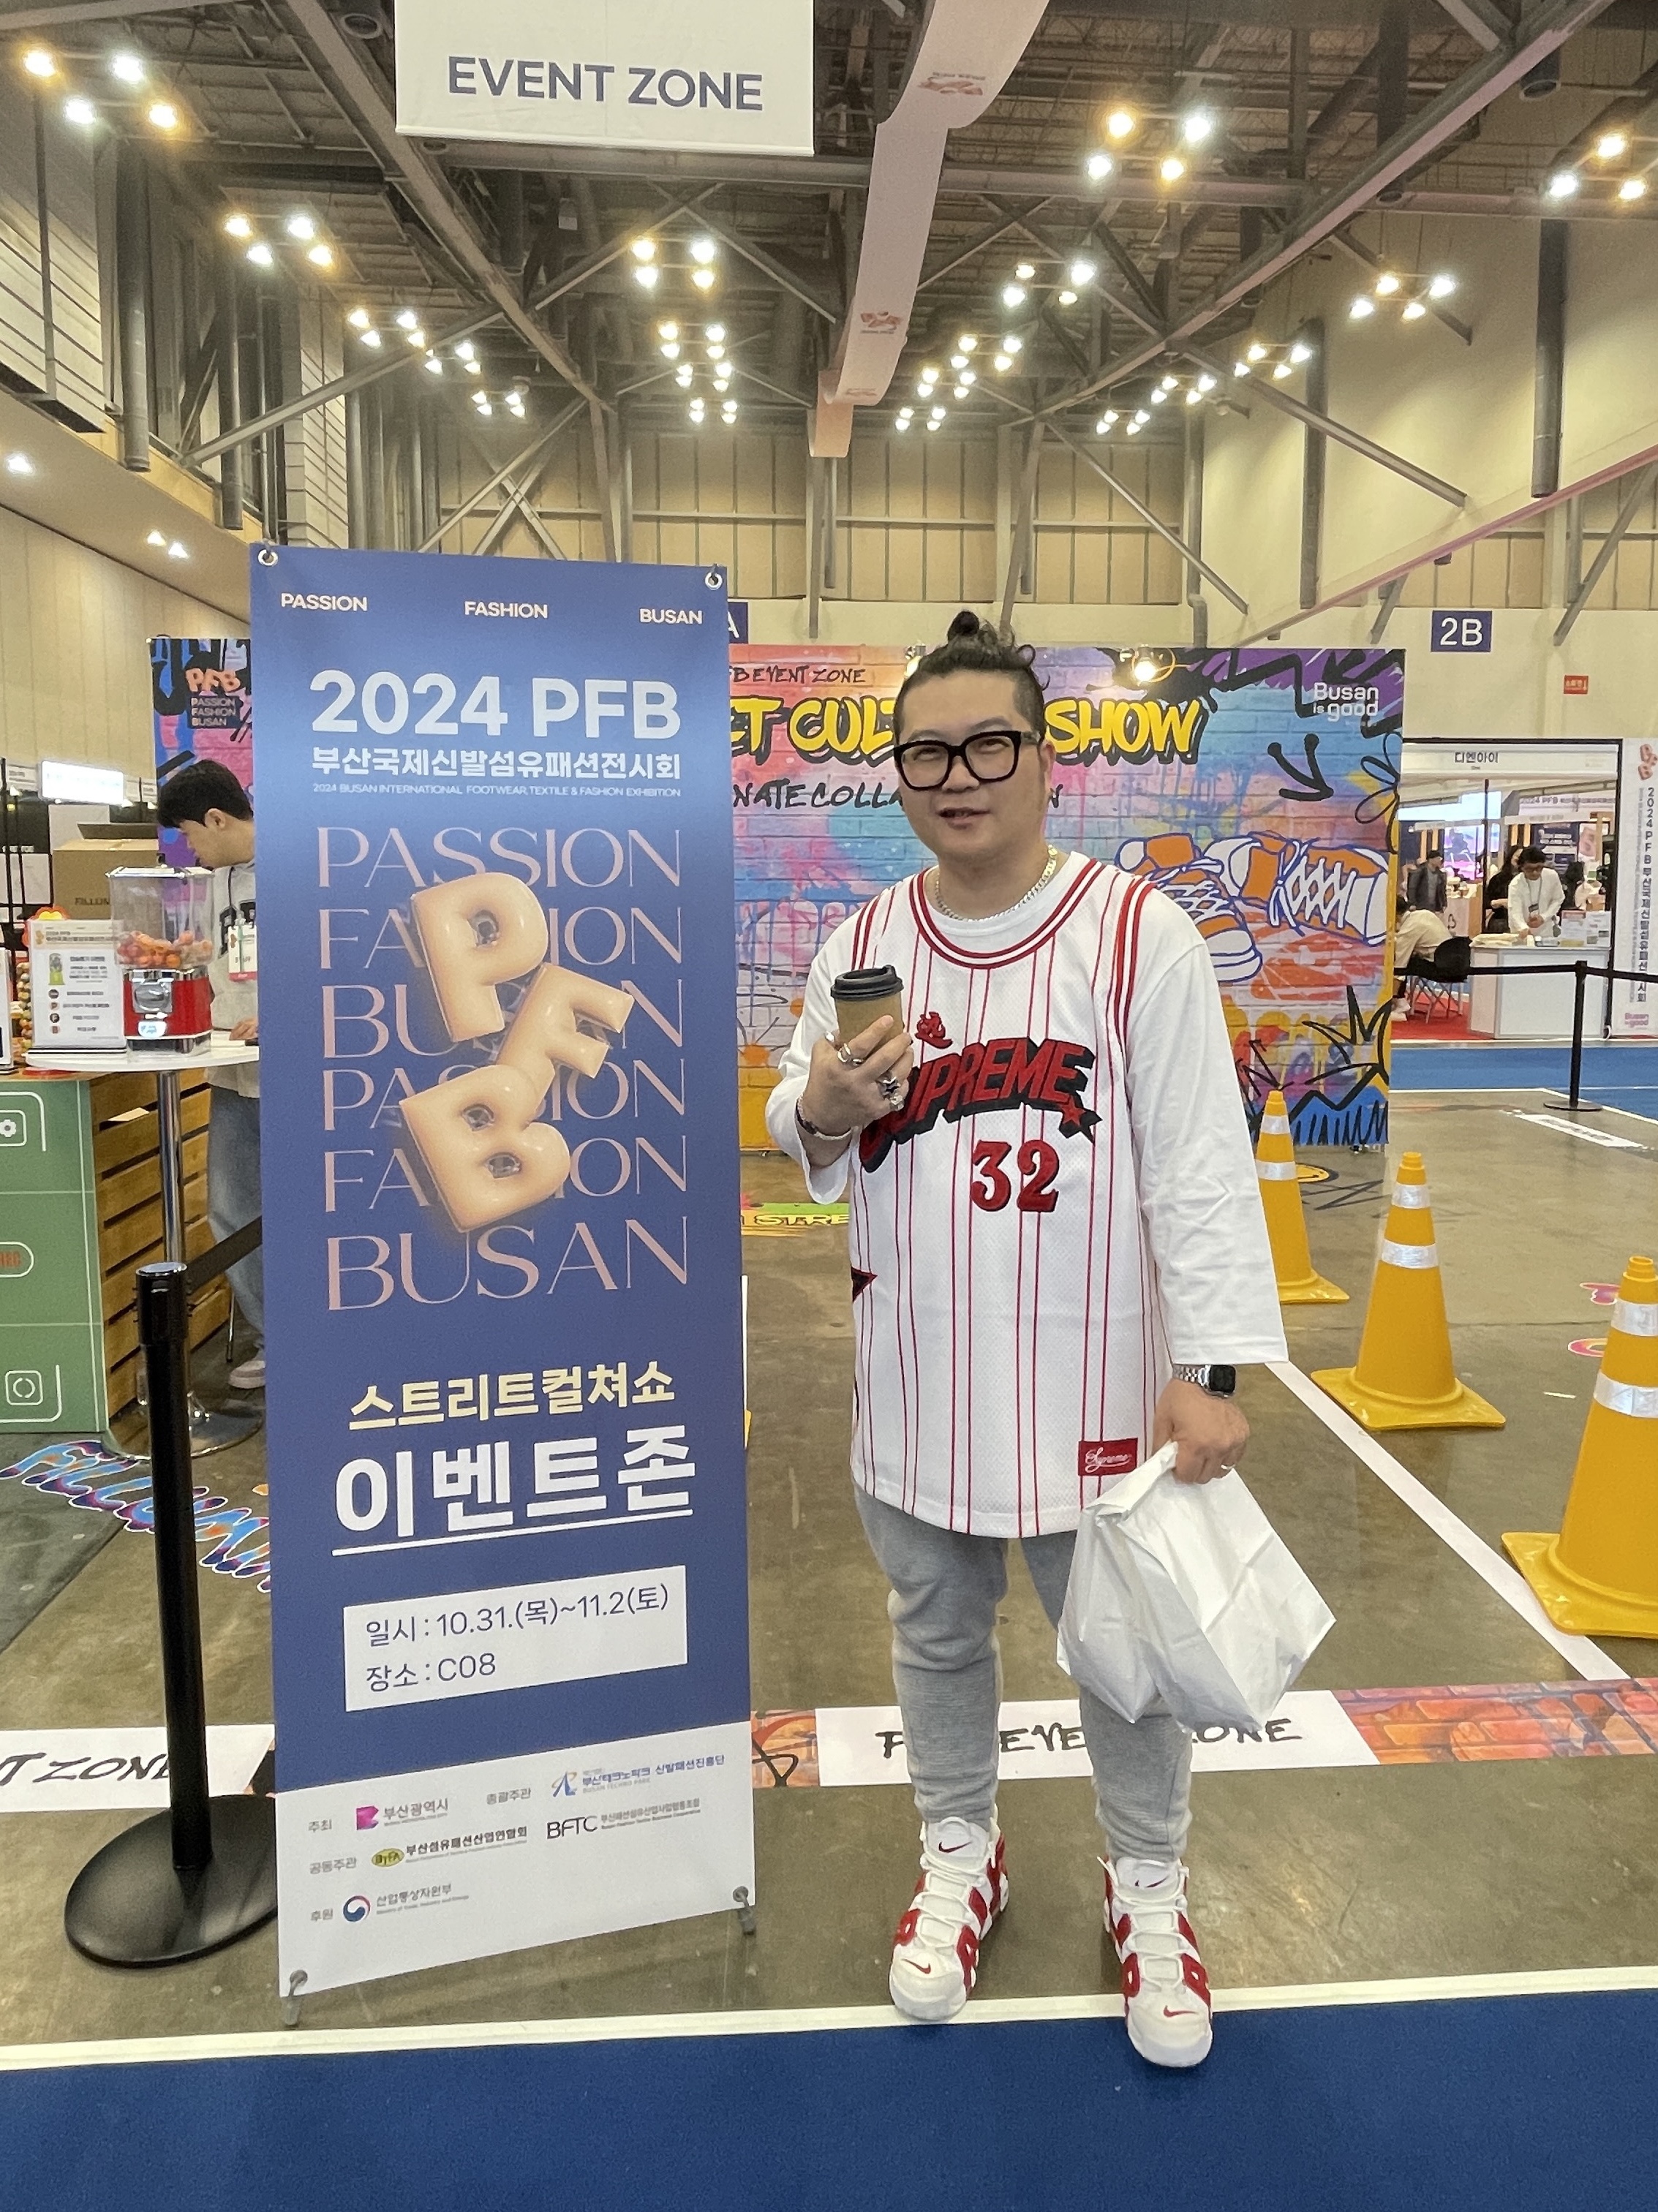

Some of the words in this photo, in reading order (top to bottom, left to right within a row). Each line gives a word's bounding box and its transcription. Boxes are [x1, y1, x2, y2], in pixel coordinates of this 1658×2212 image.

[448, 56, 614, 102] EVENT
[629, 68, 764, 111] ZONE
[281, 593, 368, 612] PASSION
[464, 600, 548, 619] FASHION
[639, 608, 703, 625] BUSAN
[1439, 616, 1483, 646] 2B
[185, 667, 241, 693] PFB
[753, 665, 808, 683] EVENT
[812, 668, 865, 683] ZONE
[191, 698, 235, 706] PASSION
[309, 669, 508, 737] 2024
[532, 677, 682, 740] PFB
[1314, 682, 1379, 701] Busan
[191, 707, 236, 717] FASHION
[192, 717, 227, 726] BUSAN
[1327, 701, 1379, 722] good
[1044, 697, 1207, 763] SHOW
[312, 747, 681, 780] 부산국제신발섬유패션전시회
[313, 783, 336, 793] 2024
[339, 784, 378, 793] BUSAN
[379, 784, 462, 795] INTERNATIONAL
[530, 785, 569, 796] TEXTILE
[570, 787, 578, 796] &
[580, 787, 623, 796] FASHION
[626, 788, 681, 797] EXHIBITION
[317, 826, 680, 888] PASSION
[319, 907, 682, 970] FAION
[321, 978, 684, 1059] BUN
[323, 1058, 685, 1130] PAION
[324, 1135, 687, 1212] FAON
[971, 1139, 1060, 1212] 32
[327, 1216, 687, 1310] BUSAN
[349, 1361, 675, 1430] 스트리트컬쳐쇼
[335, 1425, 696, 1537] 이벤트존
[438, 1653, 496, 1682] C08
[998, 1722, 1086, 1753] EVE
[1192, 1718, 1303, 1743] ONE
[383, 1798, 448, 1819] 부산광역시
[547, 1816, 598, 1840] BFTC
